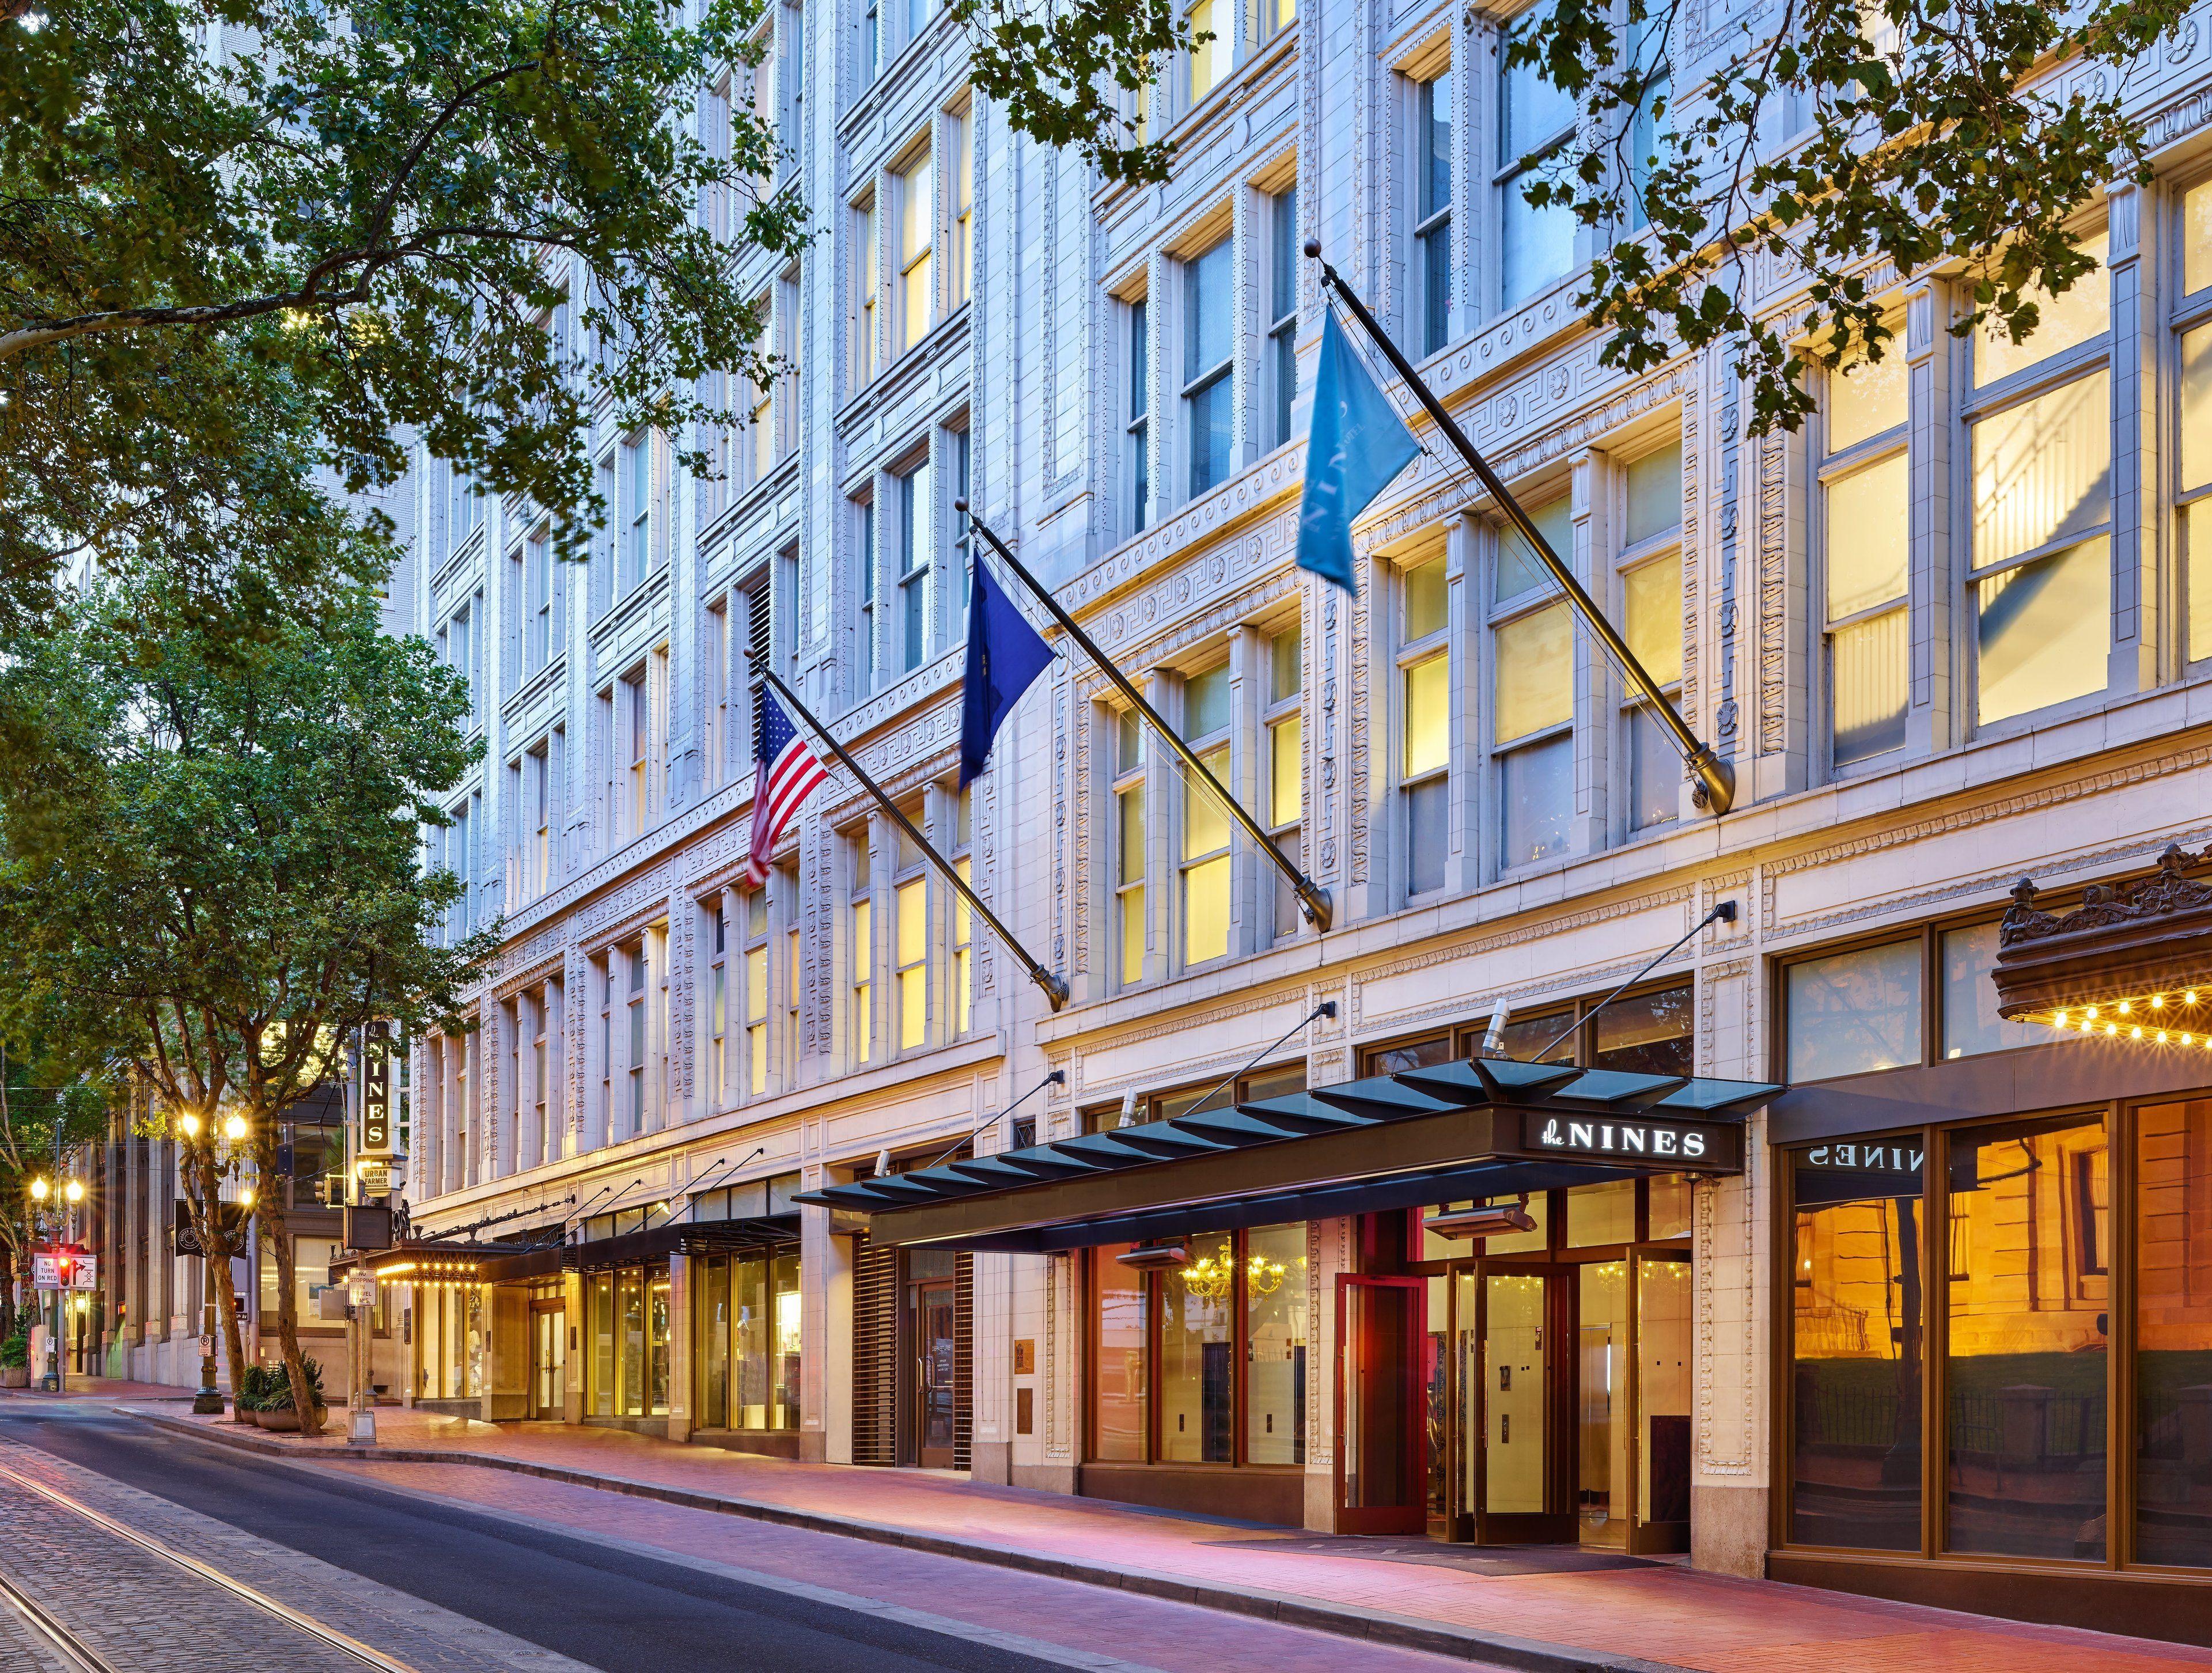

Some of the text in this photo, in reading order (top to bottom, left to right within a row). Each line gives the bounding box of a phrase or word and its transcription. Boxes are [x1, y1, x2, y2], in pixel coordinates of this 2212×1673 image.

[369, 1025, 380, 1038] the
[368, 1042, 384, 1142] NINES
[1541, 1118, 1705, 1156] the NINES
[365, 1170, 388, 1178] URBAN
